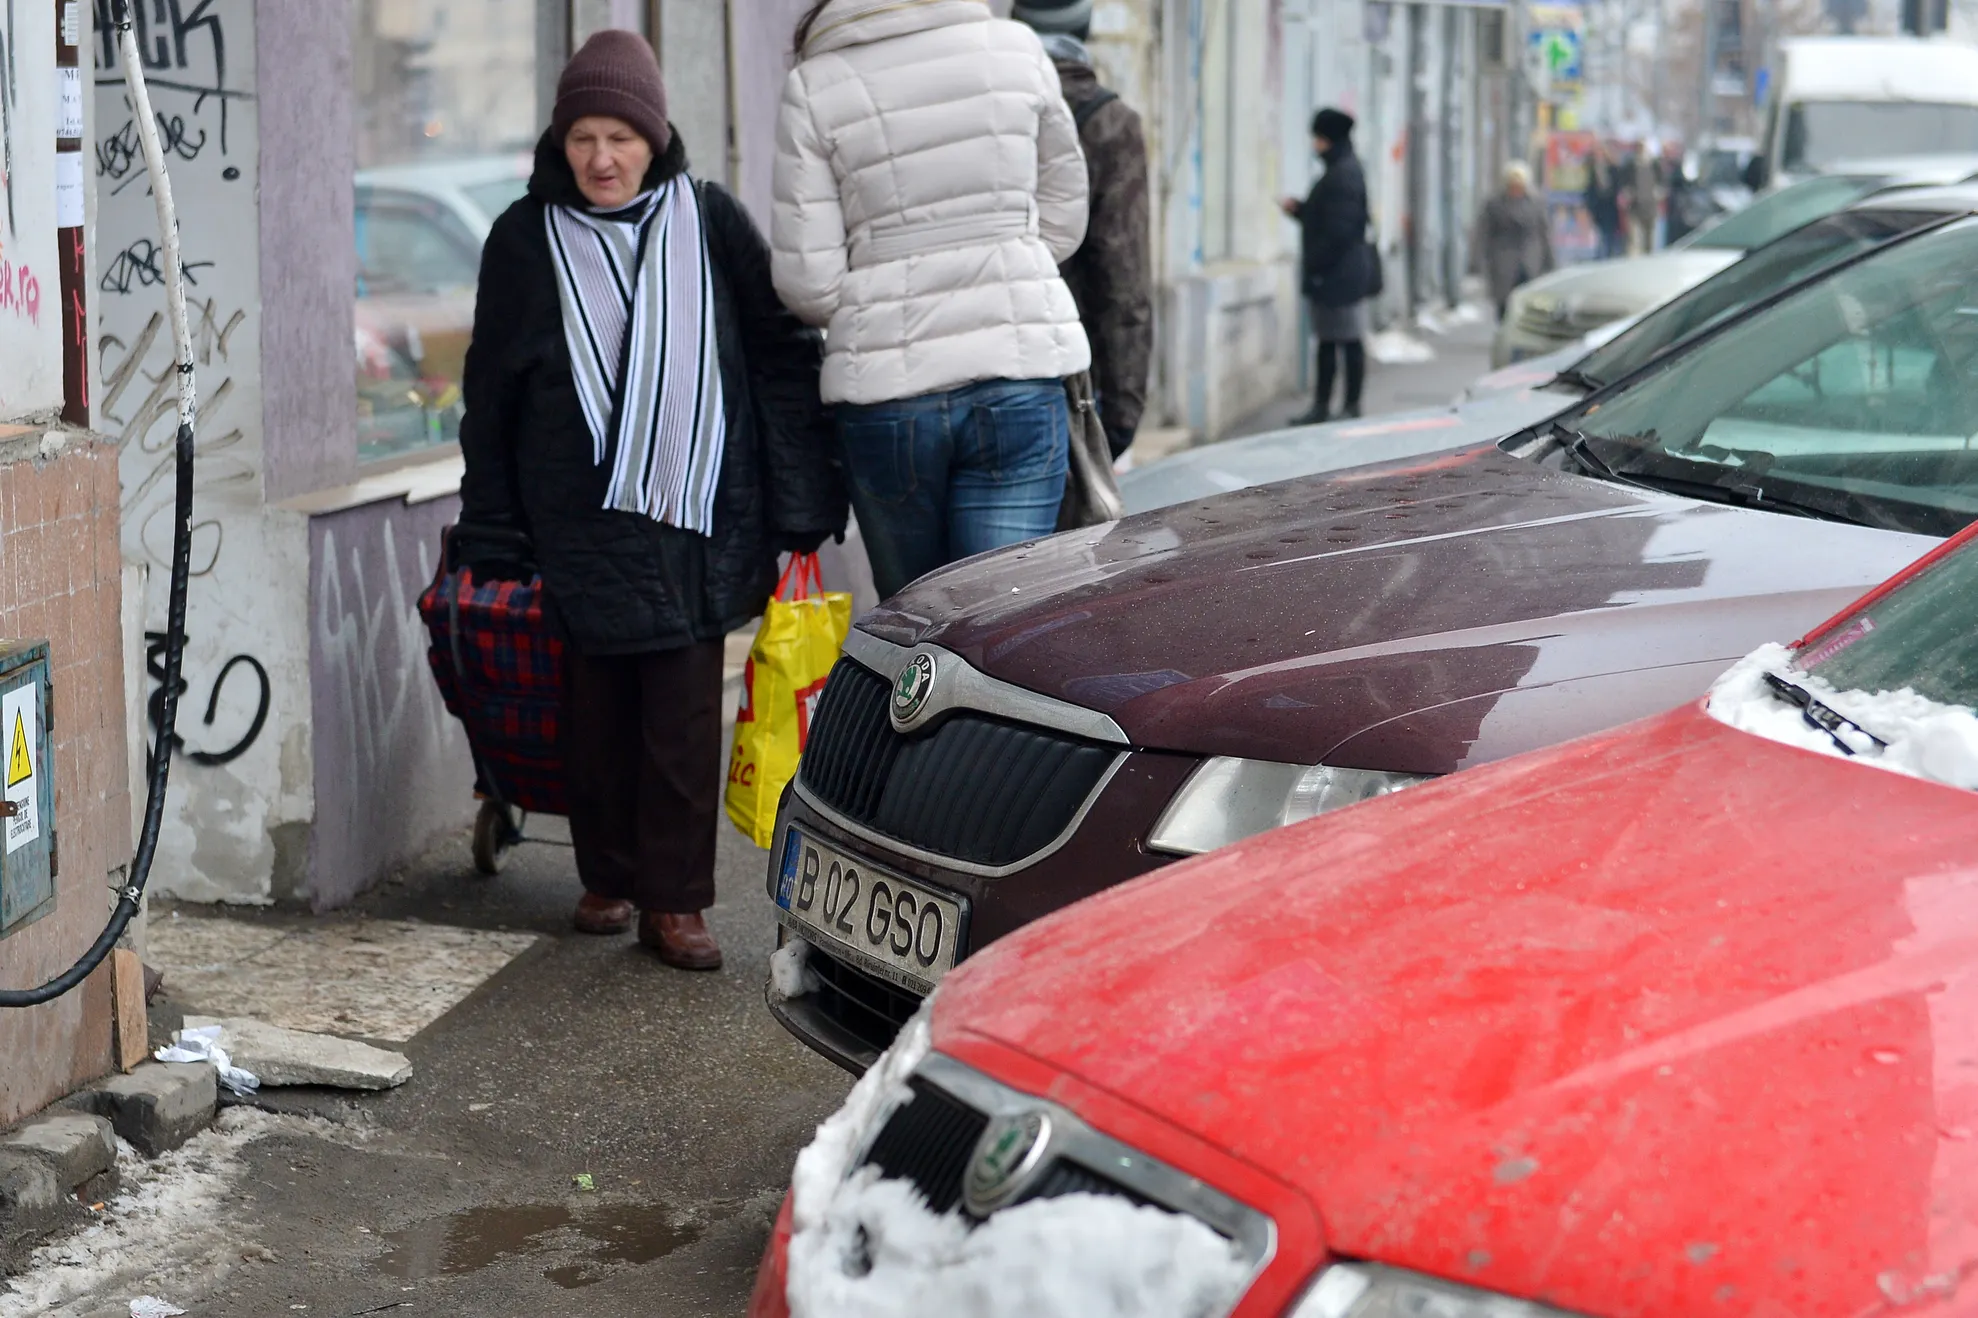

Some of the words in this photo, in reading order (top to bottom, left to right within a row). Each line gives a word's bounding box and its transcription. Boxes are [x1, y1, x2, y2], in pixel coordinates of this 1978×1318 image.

[797, 846, 819, 911] B
[823, 861, 859, 934] 02
[867, 881, 942, 968] GSO
